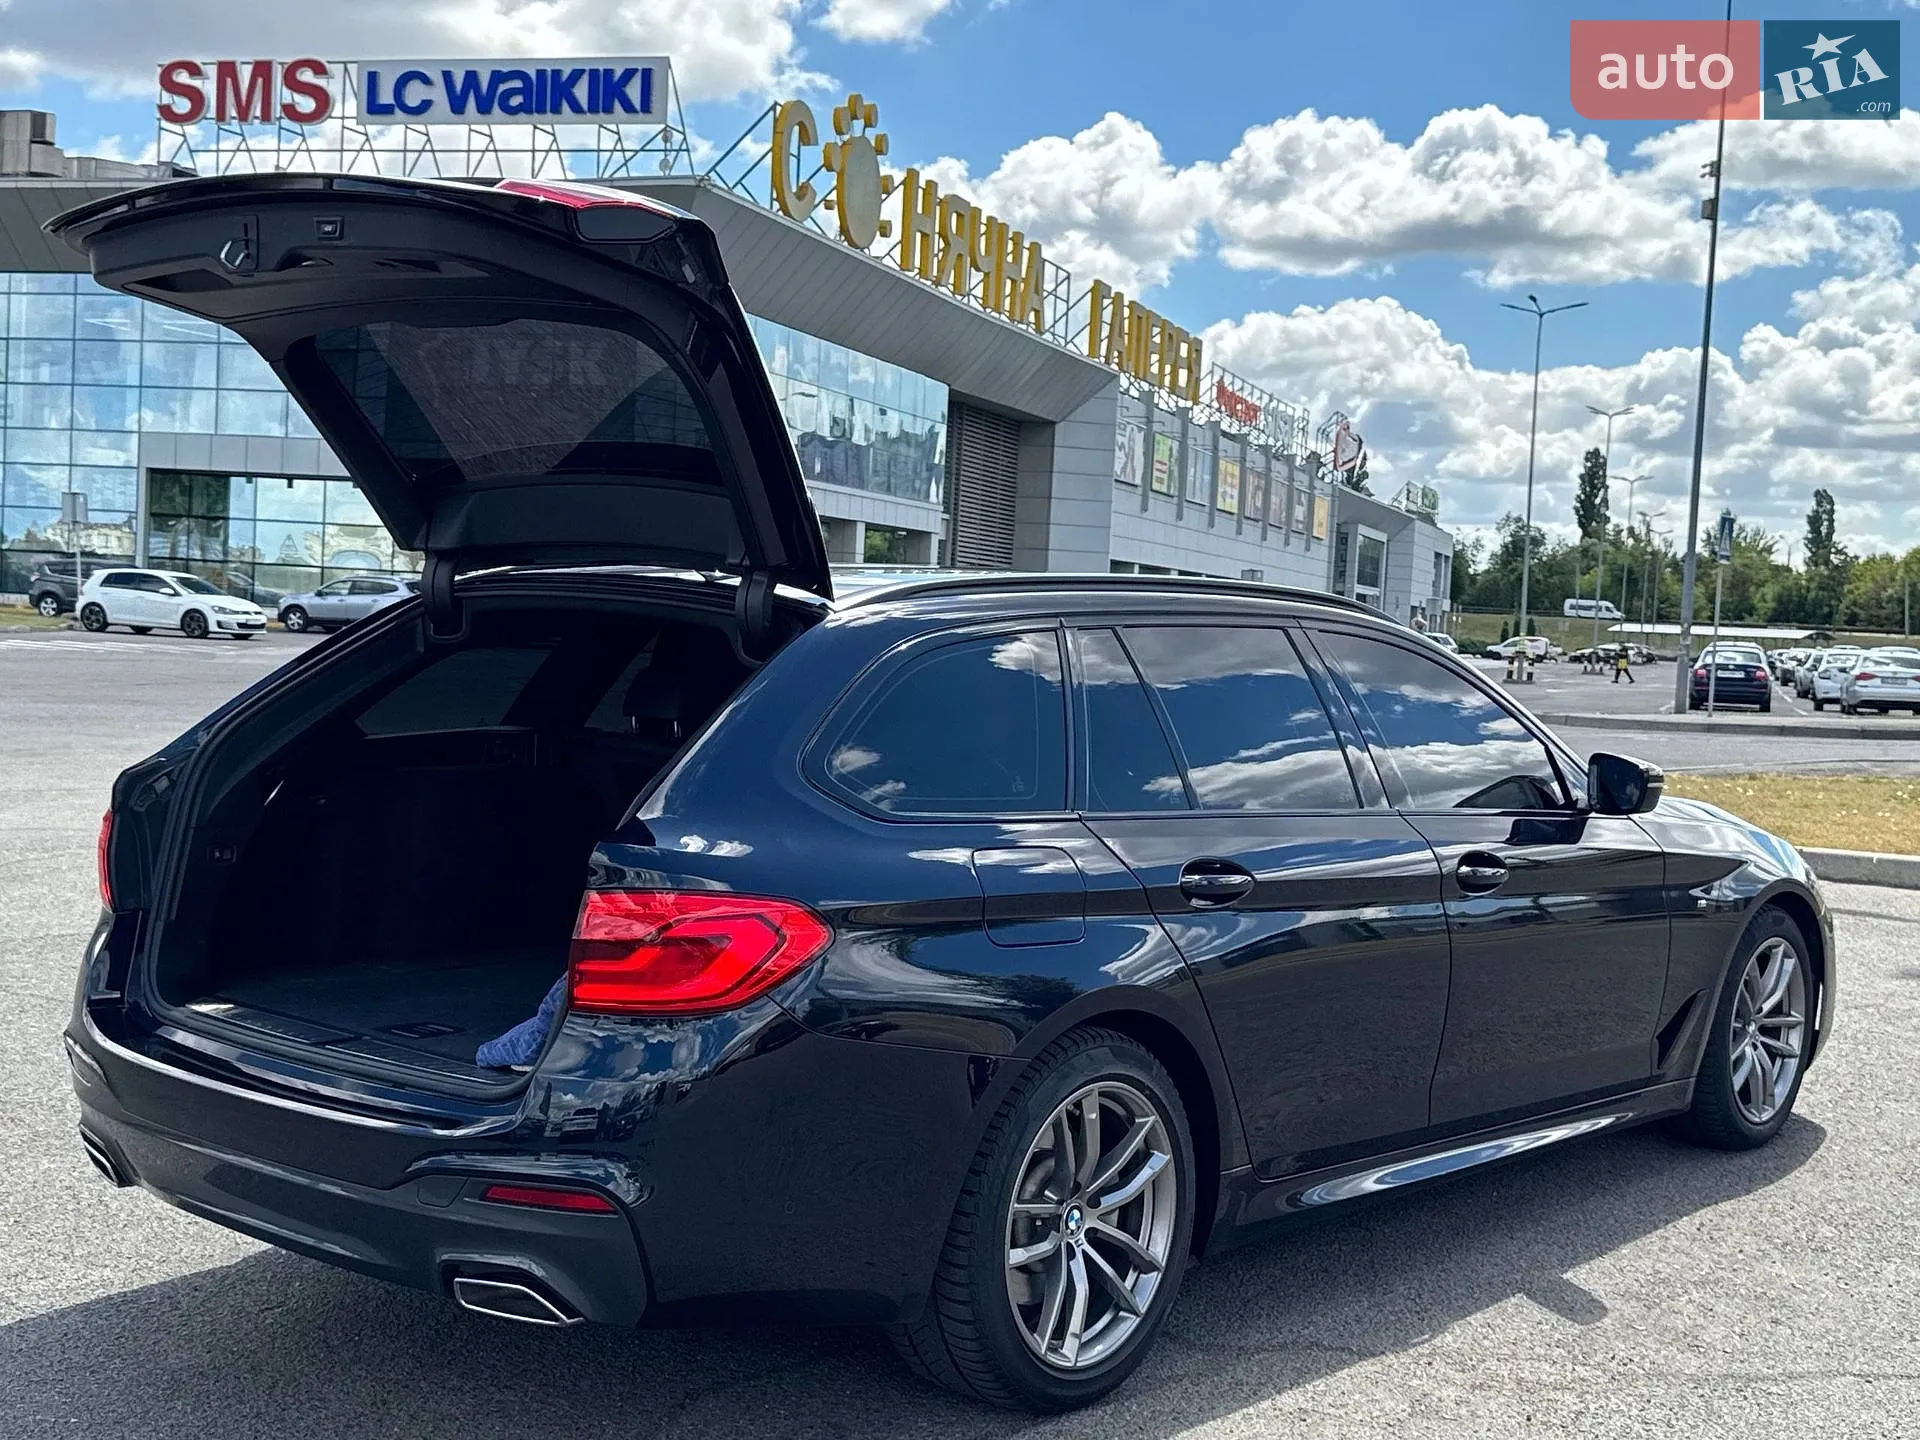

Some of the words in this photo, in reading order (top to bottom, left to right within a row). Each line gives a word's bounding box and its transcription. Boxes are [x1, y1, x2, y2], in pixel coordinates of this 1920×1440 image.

[157, 58, 334, 125] SMS
[366, 70, 434, 115] LC
[1088, 279, 1203, 405] ГАЛЕРЕЯ
